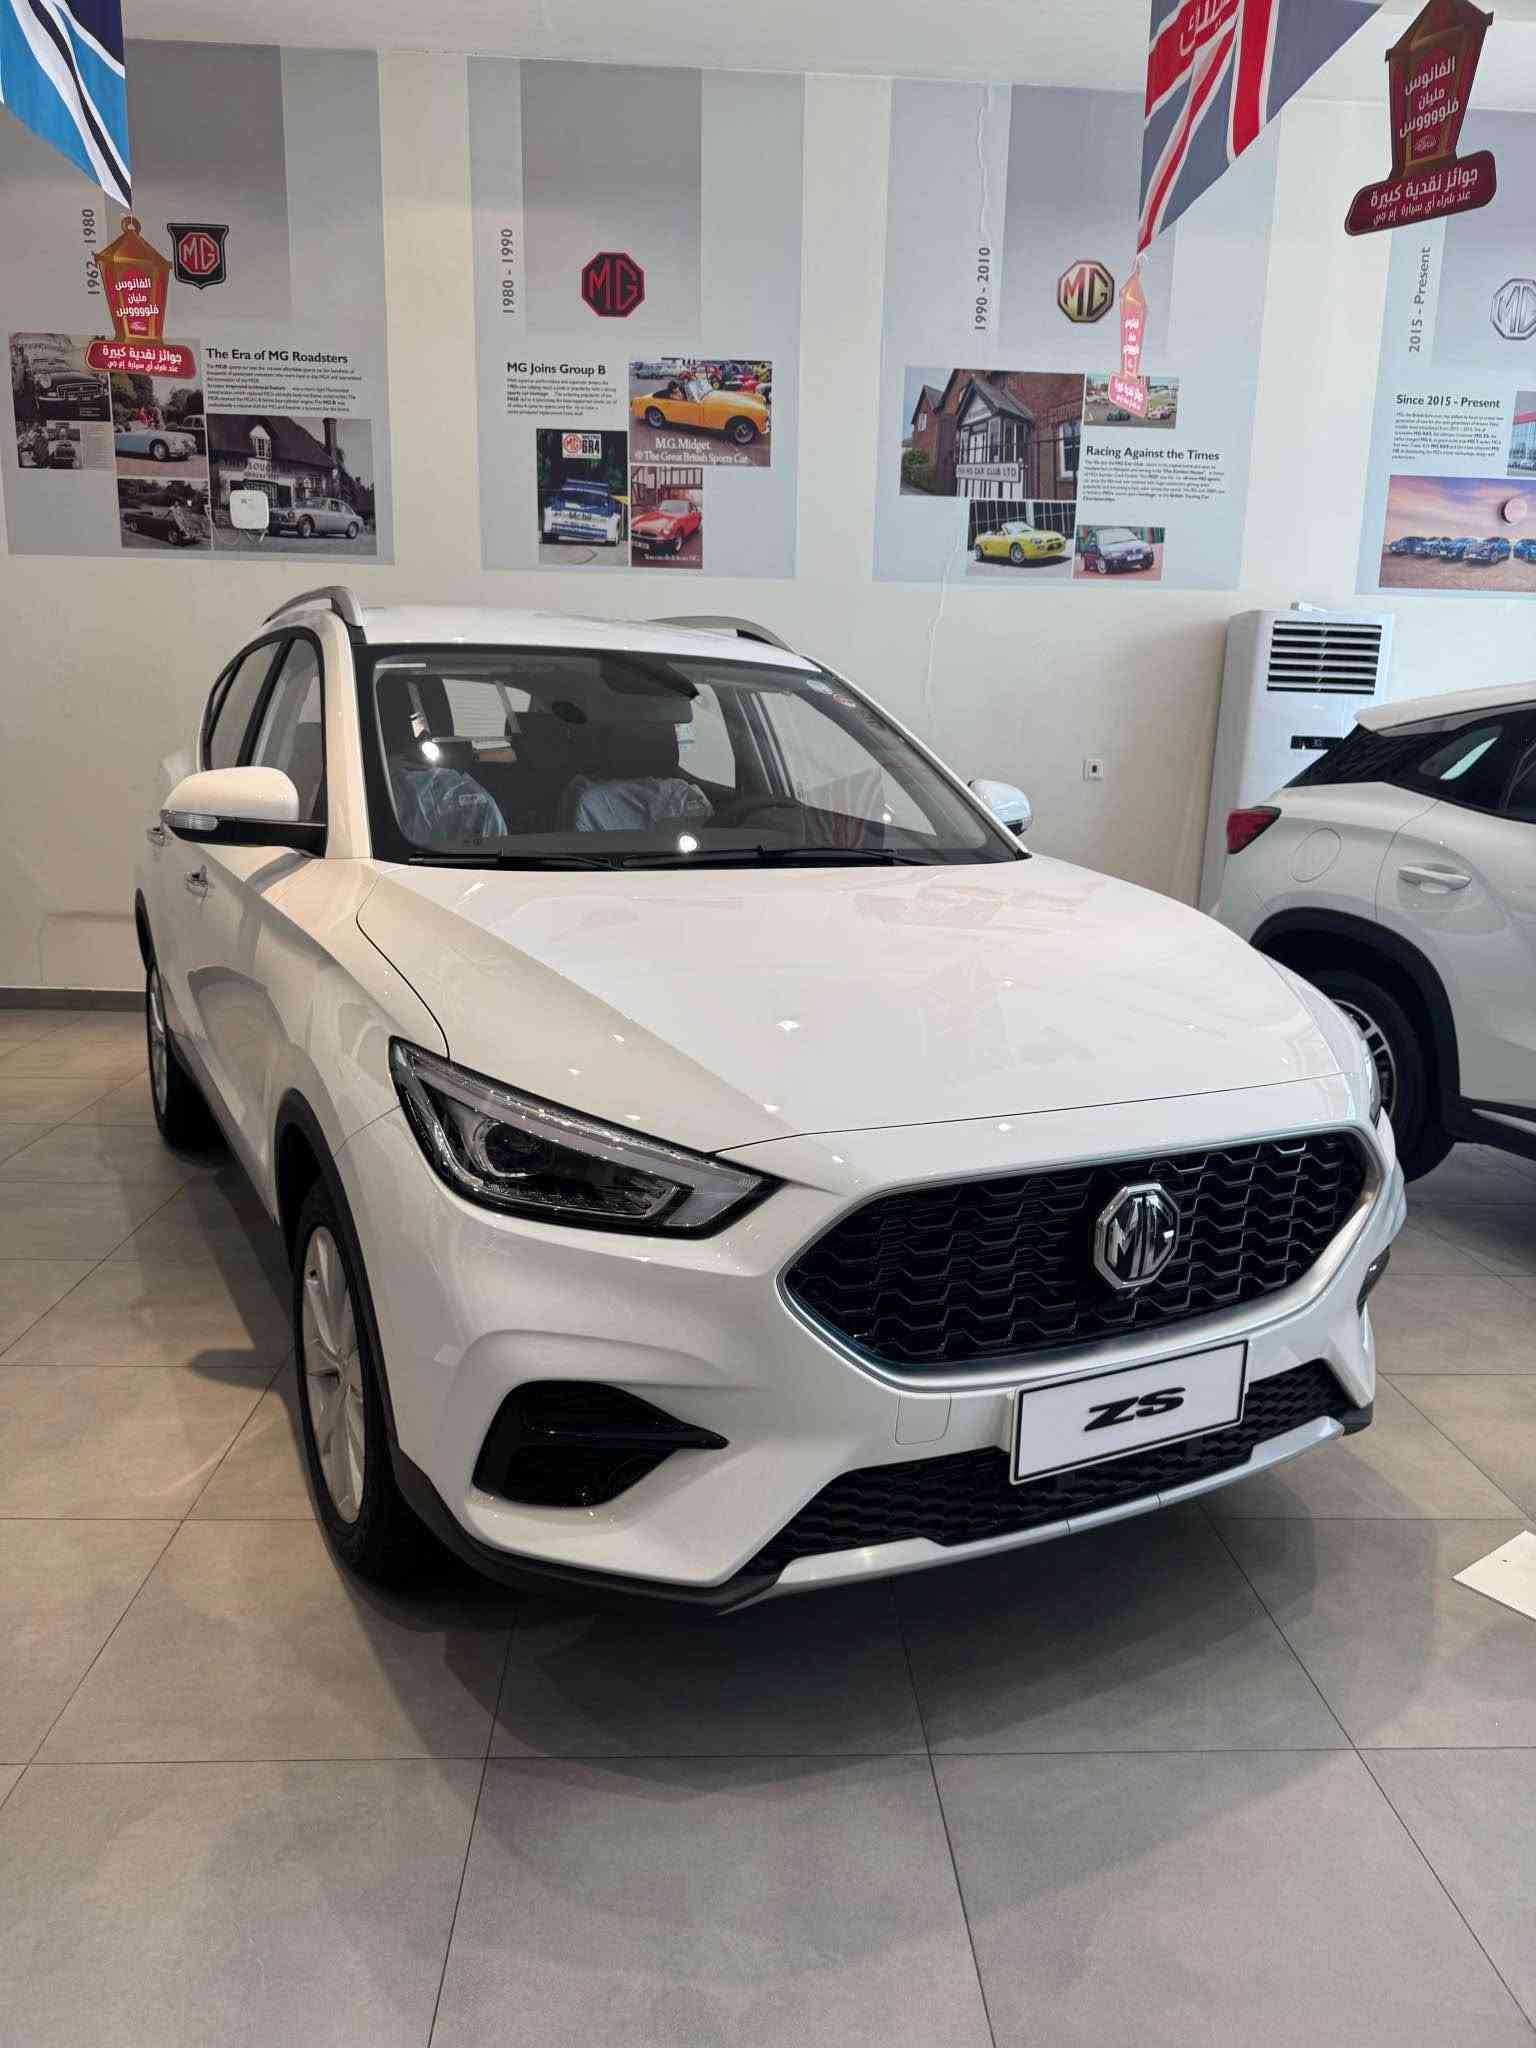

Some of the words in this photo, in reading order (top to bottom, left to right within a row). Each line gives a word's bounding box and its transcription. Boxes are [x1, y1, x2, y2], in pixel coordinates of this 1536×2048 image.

[1405, 56, 1456, 96] الفانوس
[1418, 88, 1445, 111] مليان
[1406, 173, 1442, 200] نقدية
[1445, 167, 1478, 192] جوائز
[1370, 184, 1402, 210] كبيرة
[1456, 191, 1471, 202] عند
[1401, 203, 1423, 217] سيارة
[82, 208, 96, 243] 1980
[500, 228, 514, 263] 1990
[977, 247, 991, 282] 2010
[1414, 246, 1431, 305] Present
[86, 261, 100, 295] 1962
[115, 278, 152, 291] الفانوس
[127, 293, 147, 304] مليان
[502, 279, 515, 314] 1980
[975, 296, 988, 331] 1990
[1409, 319, 1423, 353] 2015
[102, 344, 127, 360] كبيرة
[129, 347, 156, 361] نقدية
[159, 350, 182, 365] جوائز
[207, 348, 228, 360] The
[231, 349, 251, 361] Era
[254, 350, 266, 361] of
[268, 351, 289, 361] MG
[292, 351, 348, 364] Roadsters
[507, 362, 528, 373] MG
[530, 362, 557, 375] Joins
[560, 363, 595, 378] Group
[598, 364, 607, 375] B
[1396, 394, 1425, 406] Since
[1427, 395, 1452, 407] 2015
[1460, 396, 1501, 409] Present
[1086, 446, 1121, 459] Racing
[1123, 447, 1164, 460] Against
[1166, 448, 1185, 460] the
[1187, 449, 1220, 461] Times
[1106, 1194, 1175, 1279] MG
[1083, 1386, 1187, 1433] ZS
